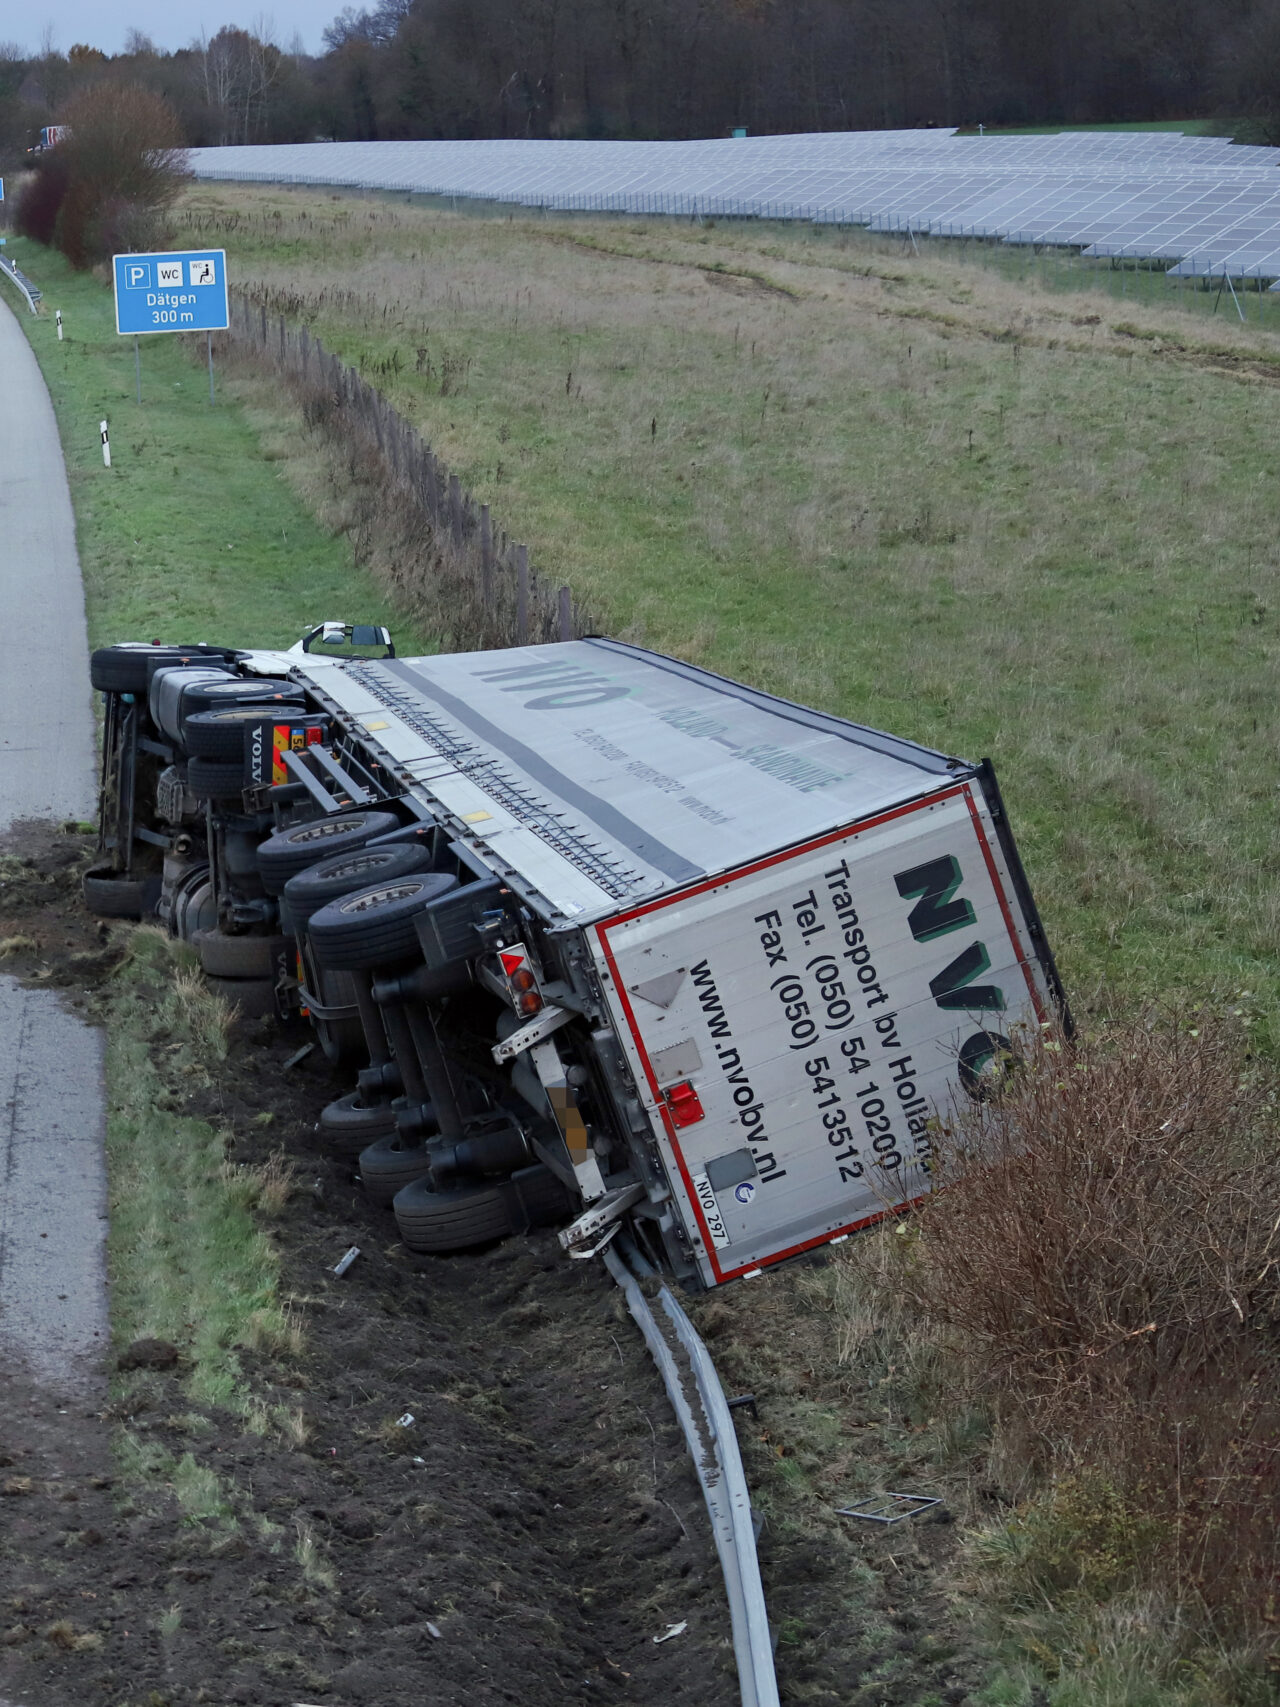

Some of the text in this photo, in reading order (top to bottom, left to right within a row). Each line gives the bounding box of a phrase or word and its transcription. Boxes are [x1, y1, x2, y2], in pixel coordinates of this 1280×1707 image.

[131, 267, 144, 286] P
[161, 269, 179, 280] WC
[147, 292, 196, 308] Dätgen
[152, 311, 194, 324] 300 m
[470, 660, 642, 710] NVO
[655, 705, 730, 738] HOLLAND
[251, 725, 262, 784] VOLV
[824, 858, 890, 1009] Transport
[873, 1011, 903, 1050] bv
[893, 853, 1015, 1103] NVO
[754, 909, 866, 1184] Fax (050) 5413512
[792, 889, 903, 1172] Tel. (050) 54 10200
[689, 958, 787, 1185] www.nvobv.nl
[696, 1181, 726, 1240] NVO 297
